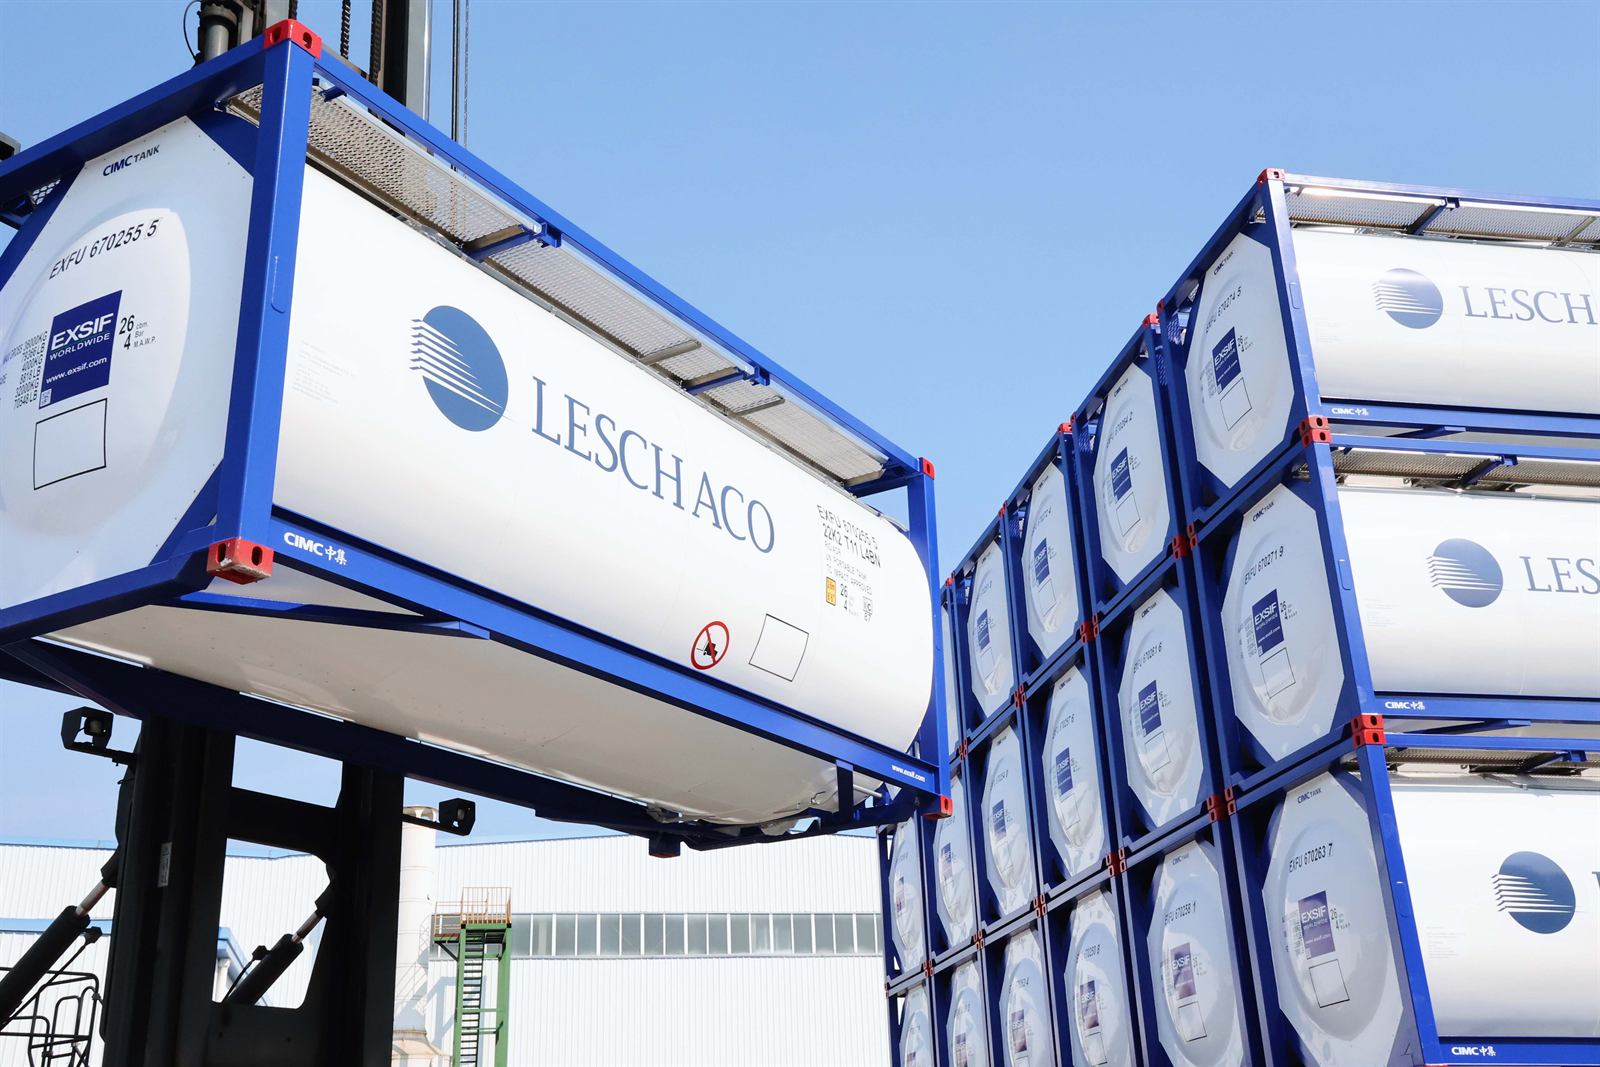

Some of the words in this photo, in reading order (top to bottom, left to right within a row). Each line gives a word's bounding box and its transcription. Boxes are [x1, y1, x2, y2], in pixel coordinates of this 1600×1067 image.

[49, 246, 88, 280] EXFU
[89, 223, 145, 258] 670255
[146, 218, 160, 238] 5
[51, 313, 115, 351] EXSIF
[119, 314, 135, 336] 26
[49, 332, 111, 361] WORLDWIDE
[123, 333, 131, 350] 4
[1214, 338, 1236, 366] EXSIF
[45, 357, 108, 384] www.exsif.com
[1331, 407, 1356, 416] CIMC
[531, 375, 775, 554] LESCHACO
[816, 504, 841, 529] EXFU
[822, 522, 843, 547] 22K2
[283, 531, 323, 557] CIMC
[324, 545, 347, 566] 中集
[1258, 549, 1279, 572] 670271
[1279, 545, 1284, 558] 9
[840, 583, 849, 598] 26
[1254, 601, 1278, 626] EXSIF
[1384, 701, 1411, 711] CIMC
[1289, 855, 1303, 873] EXFU
[1304, 845, 1326, 865] 670263
[1328, 842, 1333, 857] 7
[1301, 904, 1327, 924] EXSIF
[1330, 907, 1338, 921] 26
[1172, 954, 1190, 970] EXSIF
[1451, 1046, 1480, 1056] CIMC
